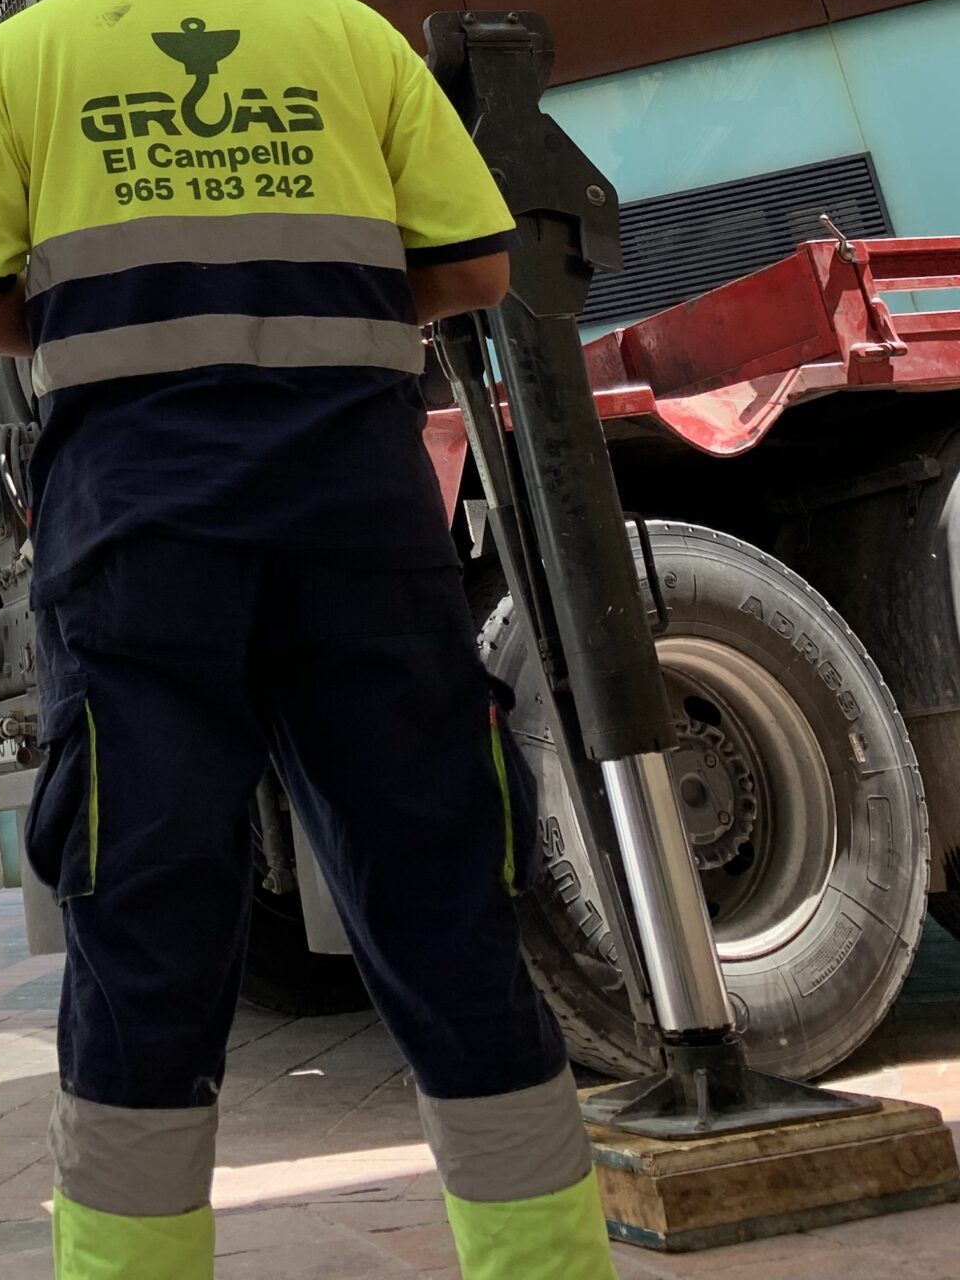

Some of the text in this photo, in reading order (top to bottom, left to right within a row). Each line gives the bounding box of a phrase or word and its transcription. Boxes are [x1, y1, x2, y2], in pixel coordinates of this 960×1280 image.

[81, 86, 324, 142] GRUAS
[103, 141, 314, 174] El Campello
[115, 173, 315, 206] 965 183 242
[738, 595, 862, 720] ADR69
